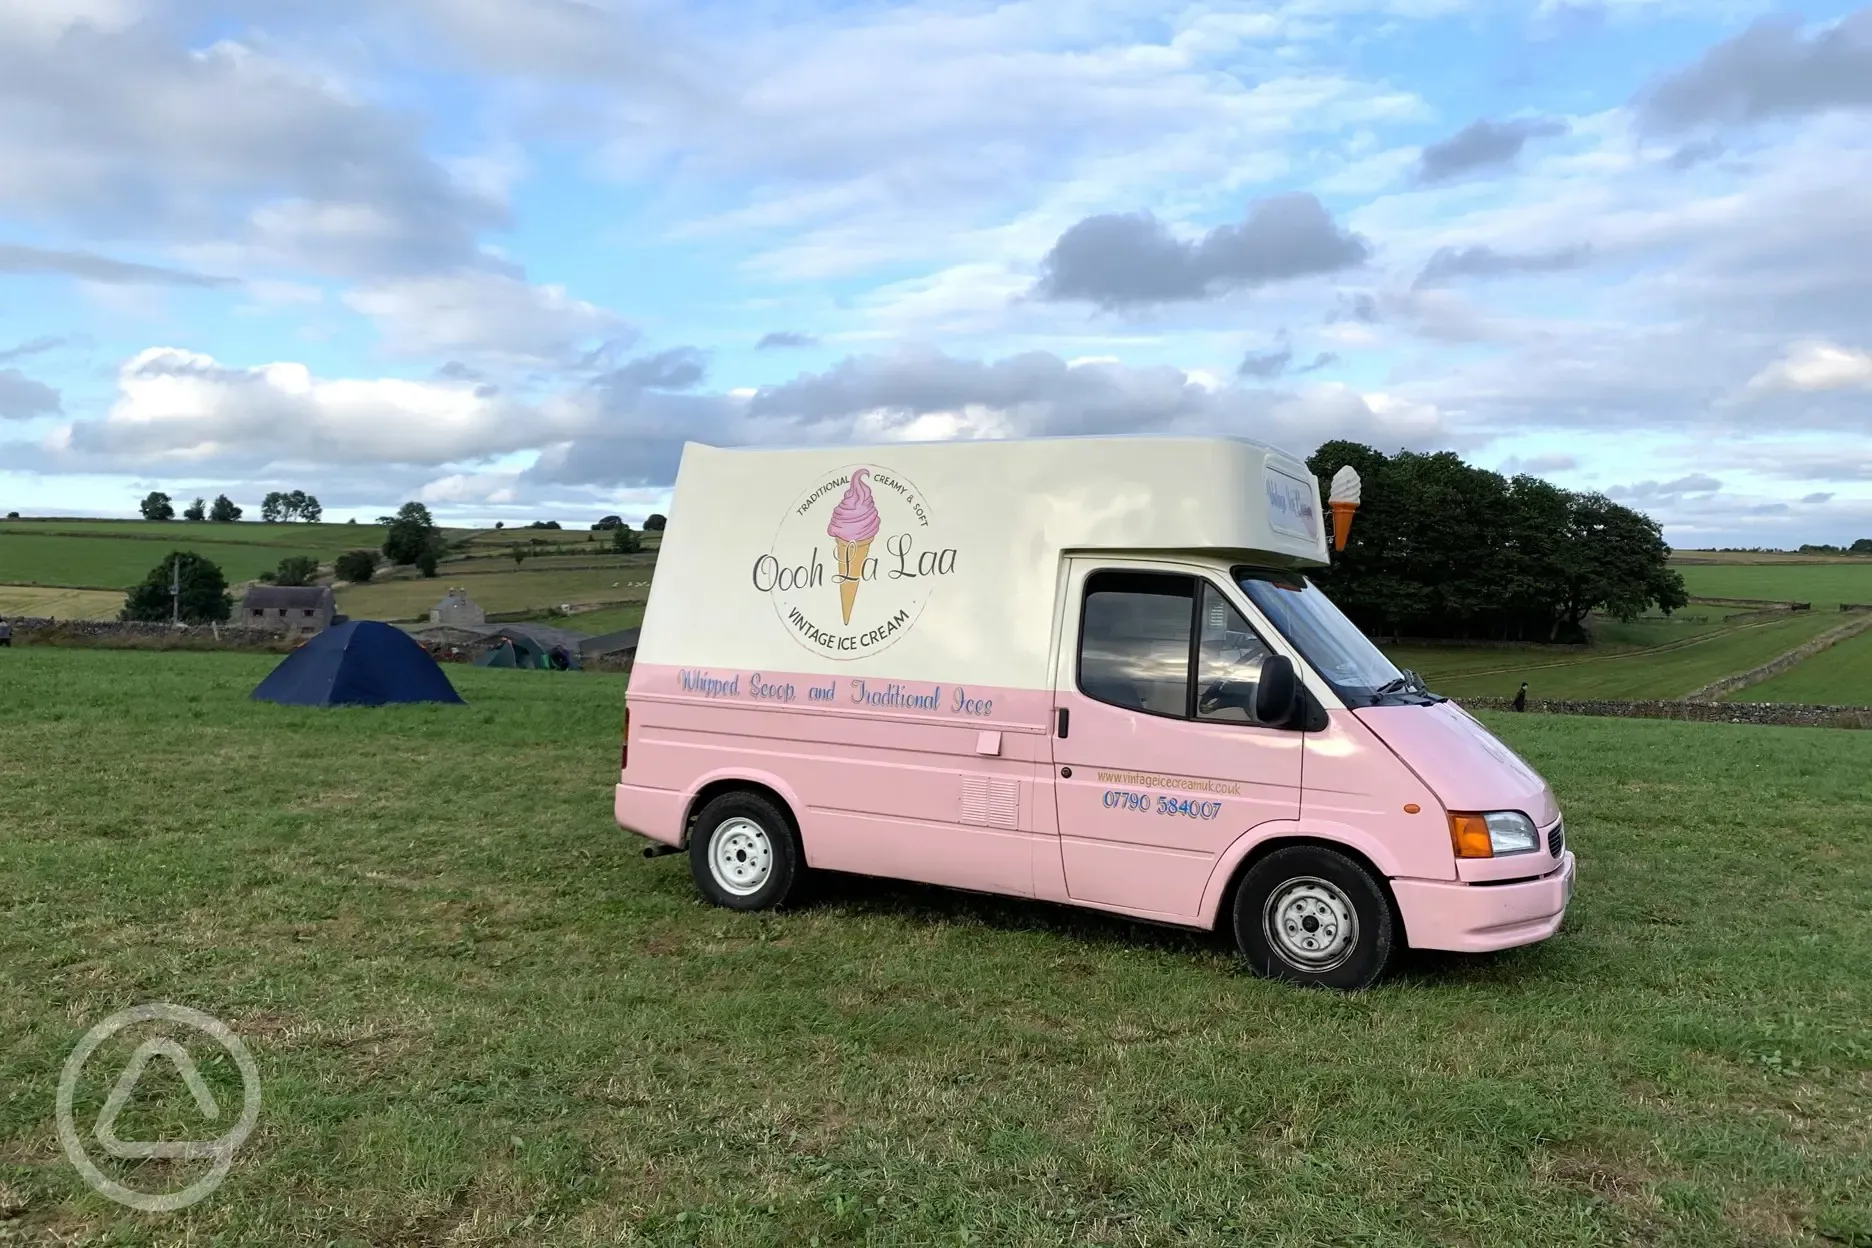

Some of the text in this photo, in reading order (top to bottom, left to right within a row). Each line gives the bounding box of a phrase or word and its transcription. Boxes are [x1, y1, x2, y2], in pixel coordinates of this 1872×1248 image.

[796, 475, 850, 516] TRADITIONAL
[873, 474, 928, 528] CREAMY & SOFT
[752, 533, 957, 592] Oooh La Laa
[788, 606, 909, 651] VINTAGE ICE CREAM
[807, 681, 836, 701] and
[850, 679, 940, 711] Traditional
[950, 686, 993, 716] Ices
[1103, 790, 1222, 820] 07790 584007
